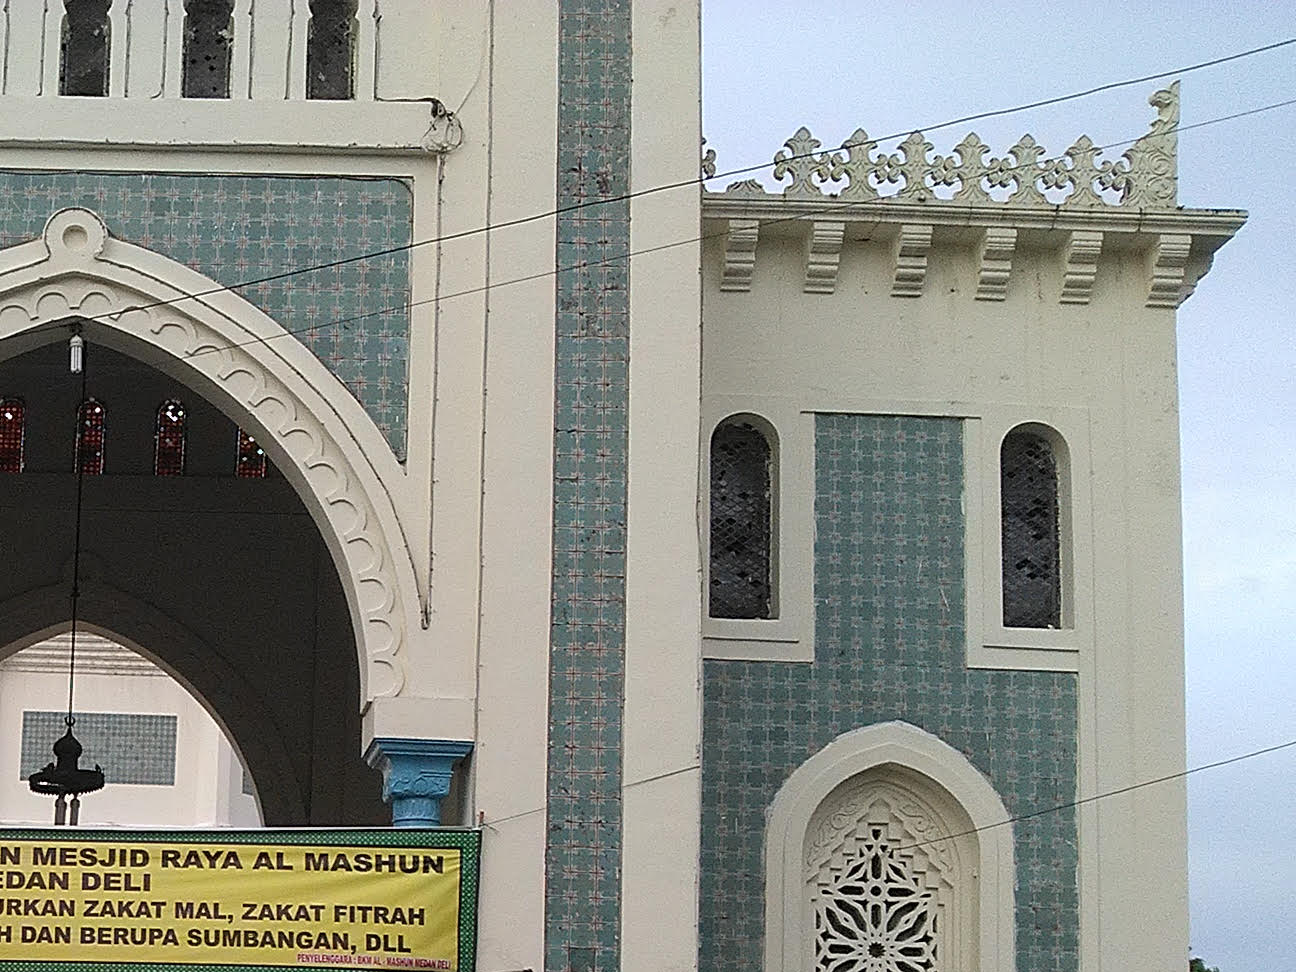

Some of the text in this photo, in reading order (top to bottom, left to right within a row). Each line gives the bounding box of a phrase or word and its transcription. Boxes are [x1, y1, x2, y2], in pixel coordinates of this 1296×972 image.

[32, 847, 150, 868] MESJID
[161, 850, 243, 870] RAYA
[253, 852, 293, 871] AL
[304, 853, 445, 874] MASHUN
[81, 873, 151, 892] DELI
[83, 900, 167, 919] ZAKAT
[174, 902, 234, 924] MAL,
[241, 904, 325, 922] ZAKAT
[334, 906, 426, 926] FITRAH
[21, 926, 72, 944] DAN
[80, 927, 179, 948] BERUPA
[187, 929, 357, 955] SUMBANGAN,
[365, 933, 412, 953] DLL
